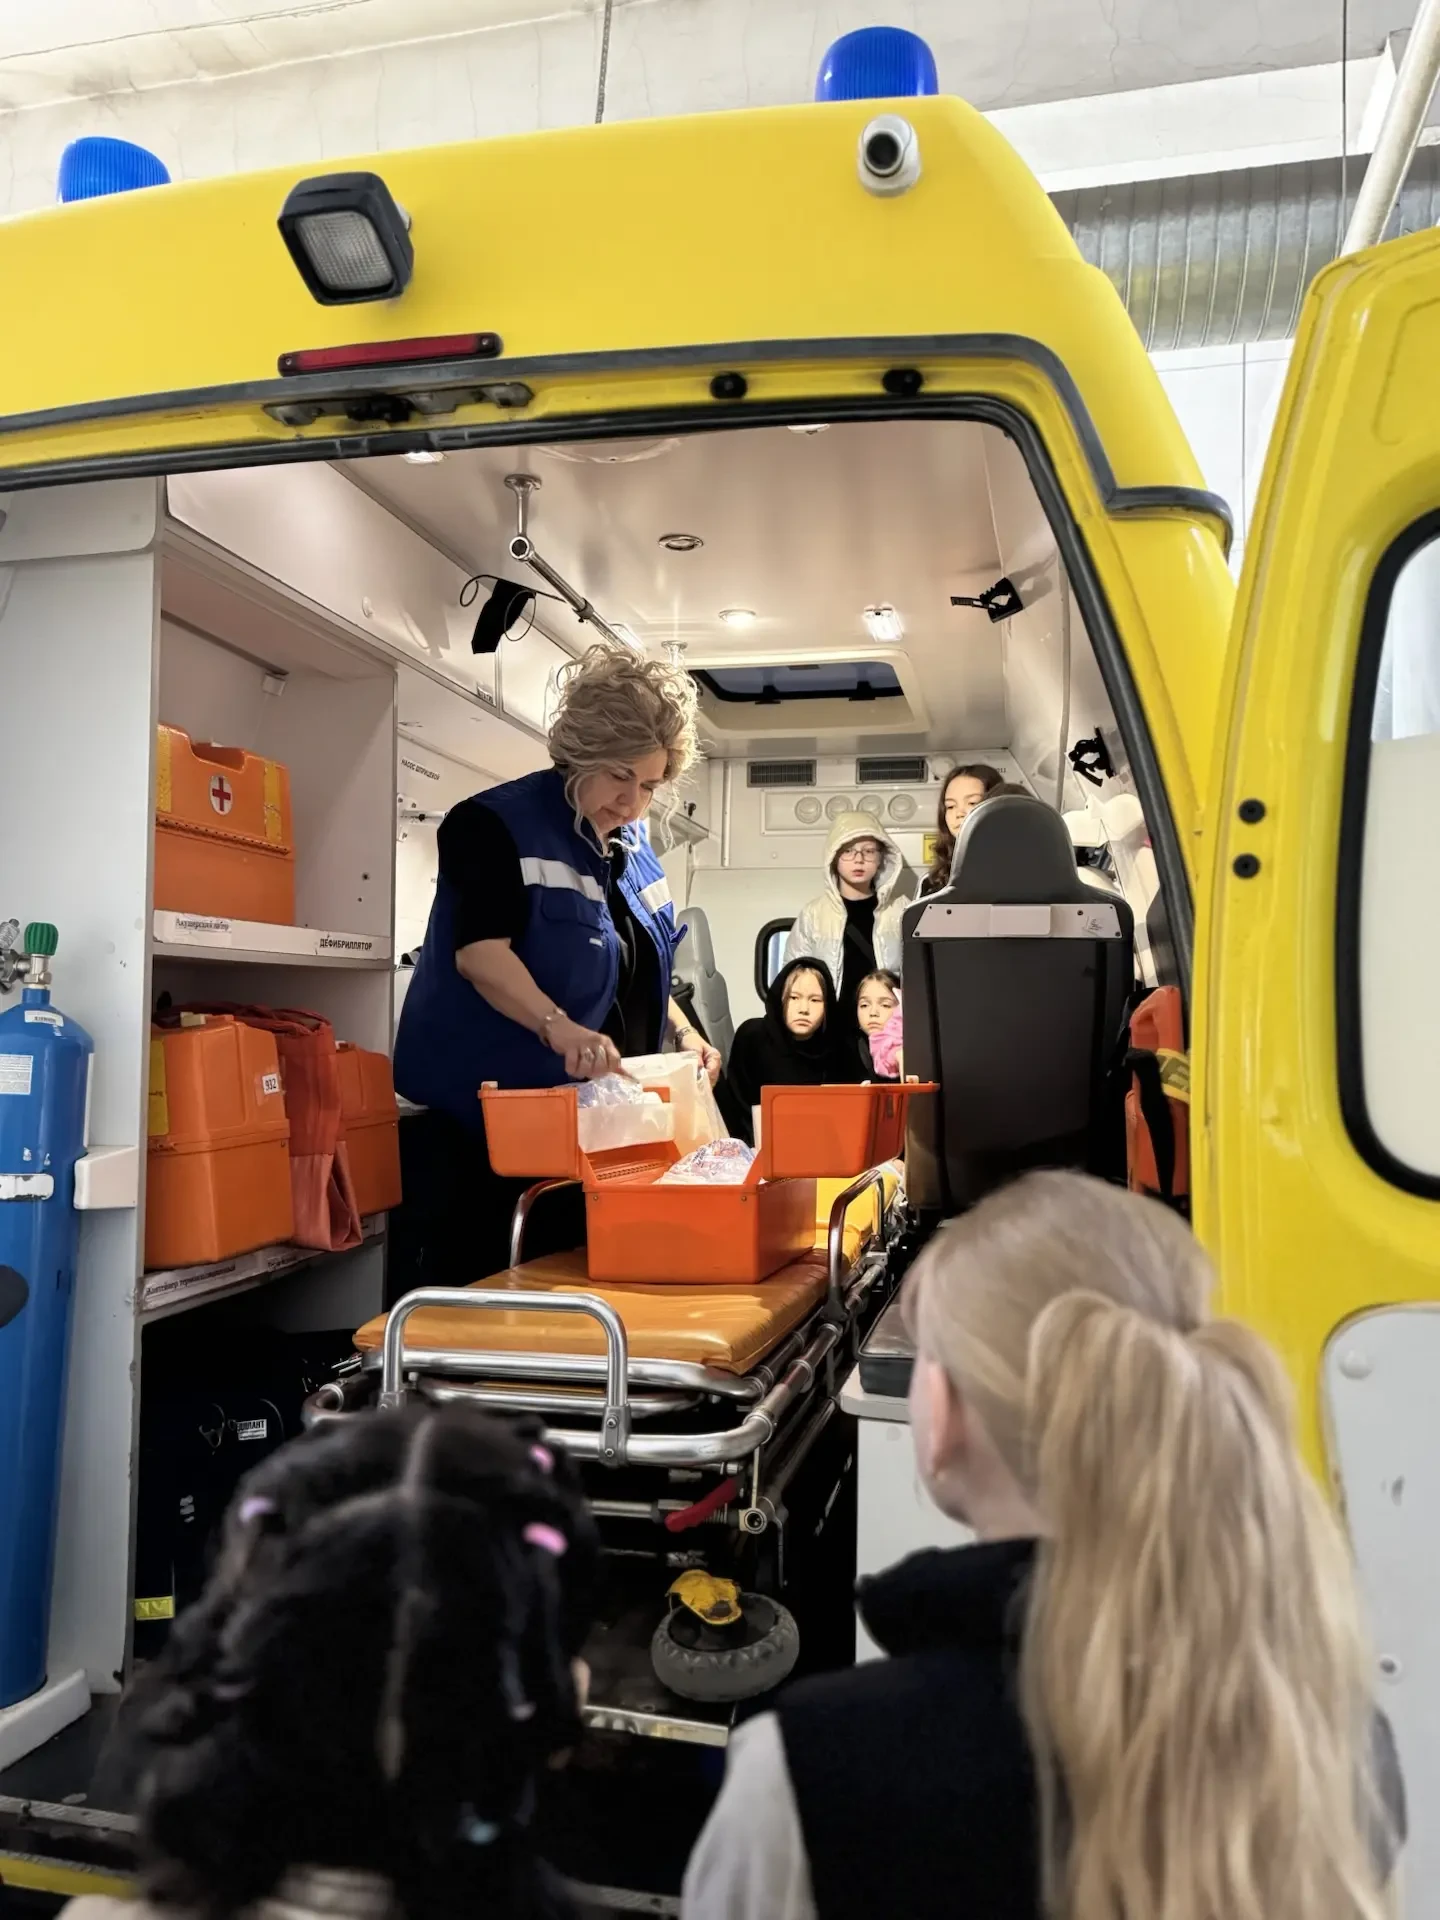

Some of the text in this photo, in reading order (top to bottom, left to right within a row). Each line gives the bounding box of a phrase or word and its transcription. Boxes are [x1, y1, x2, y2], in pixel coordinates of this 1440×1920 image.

[176, 918, 213, 929] Акушерский
[320, 938, 372, 950] ДЕФИБРИЛЛЯТОР
[264, 1078, 276, 1091] 932
